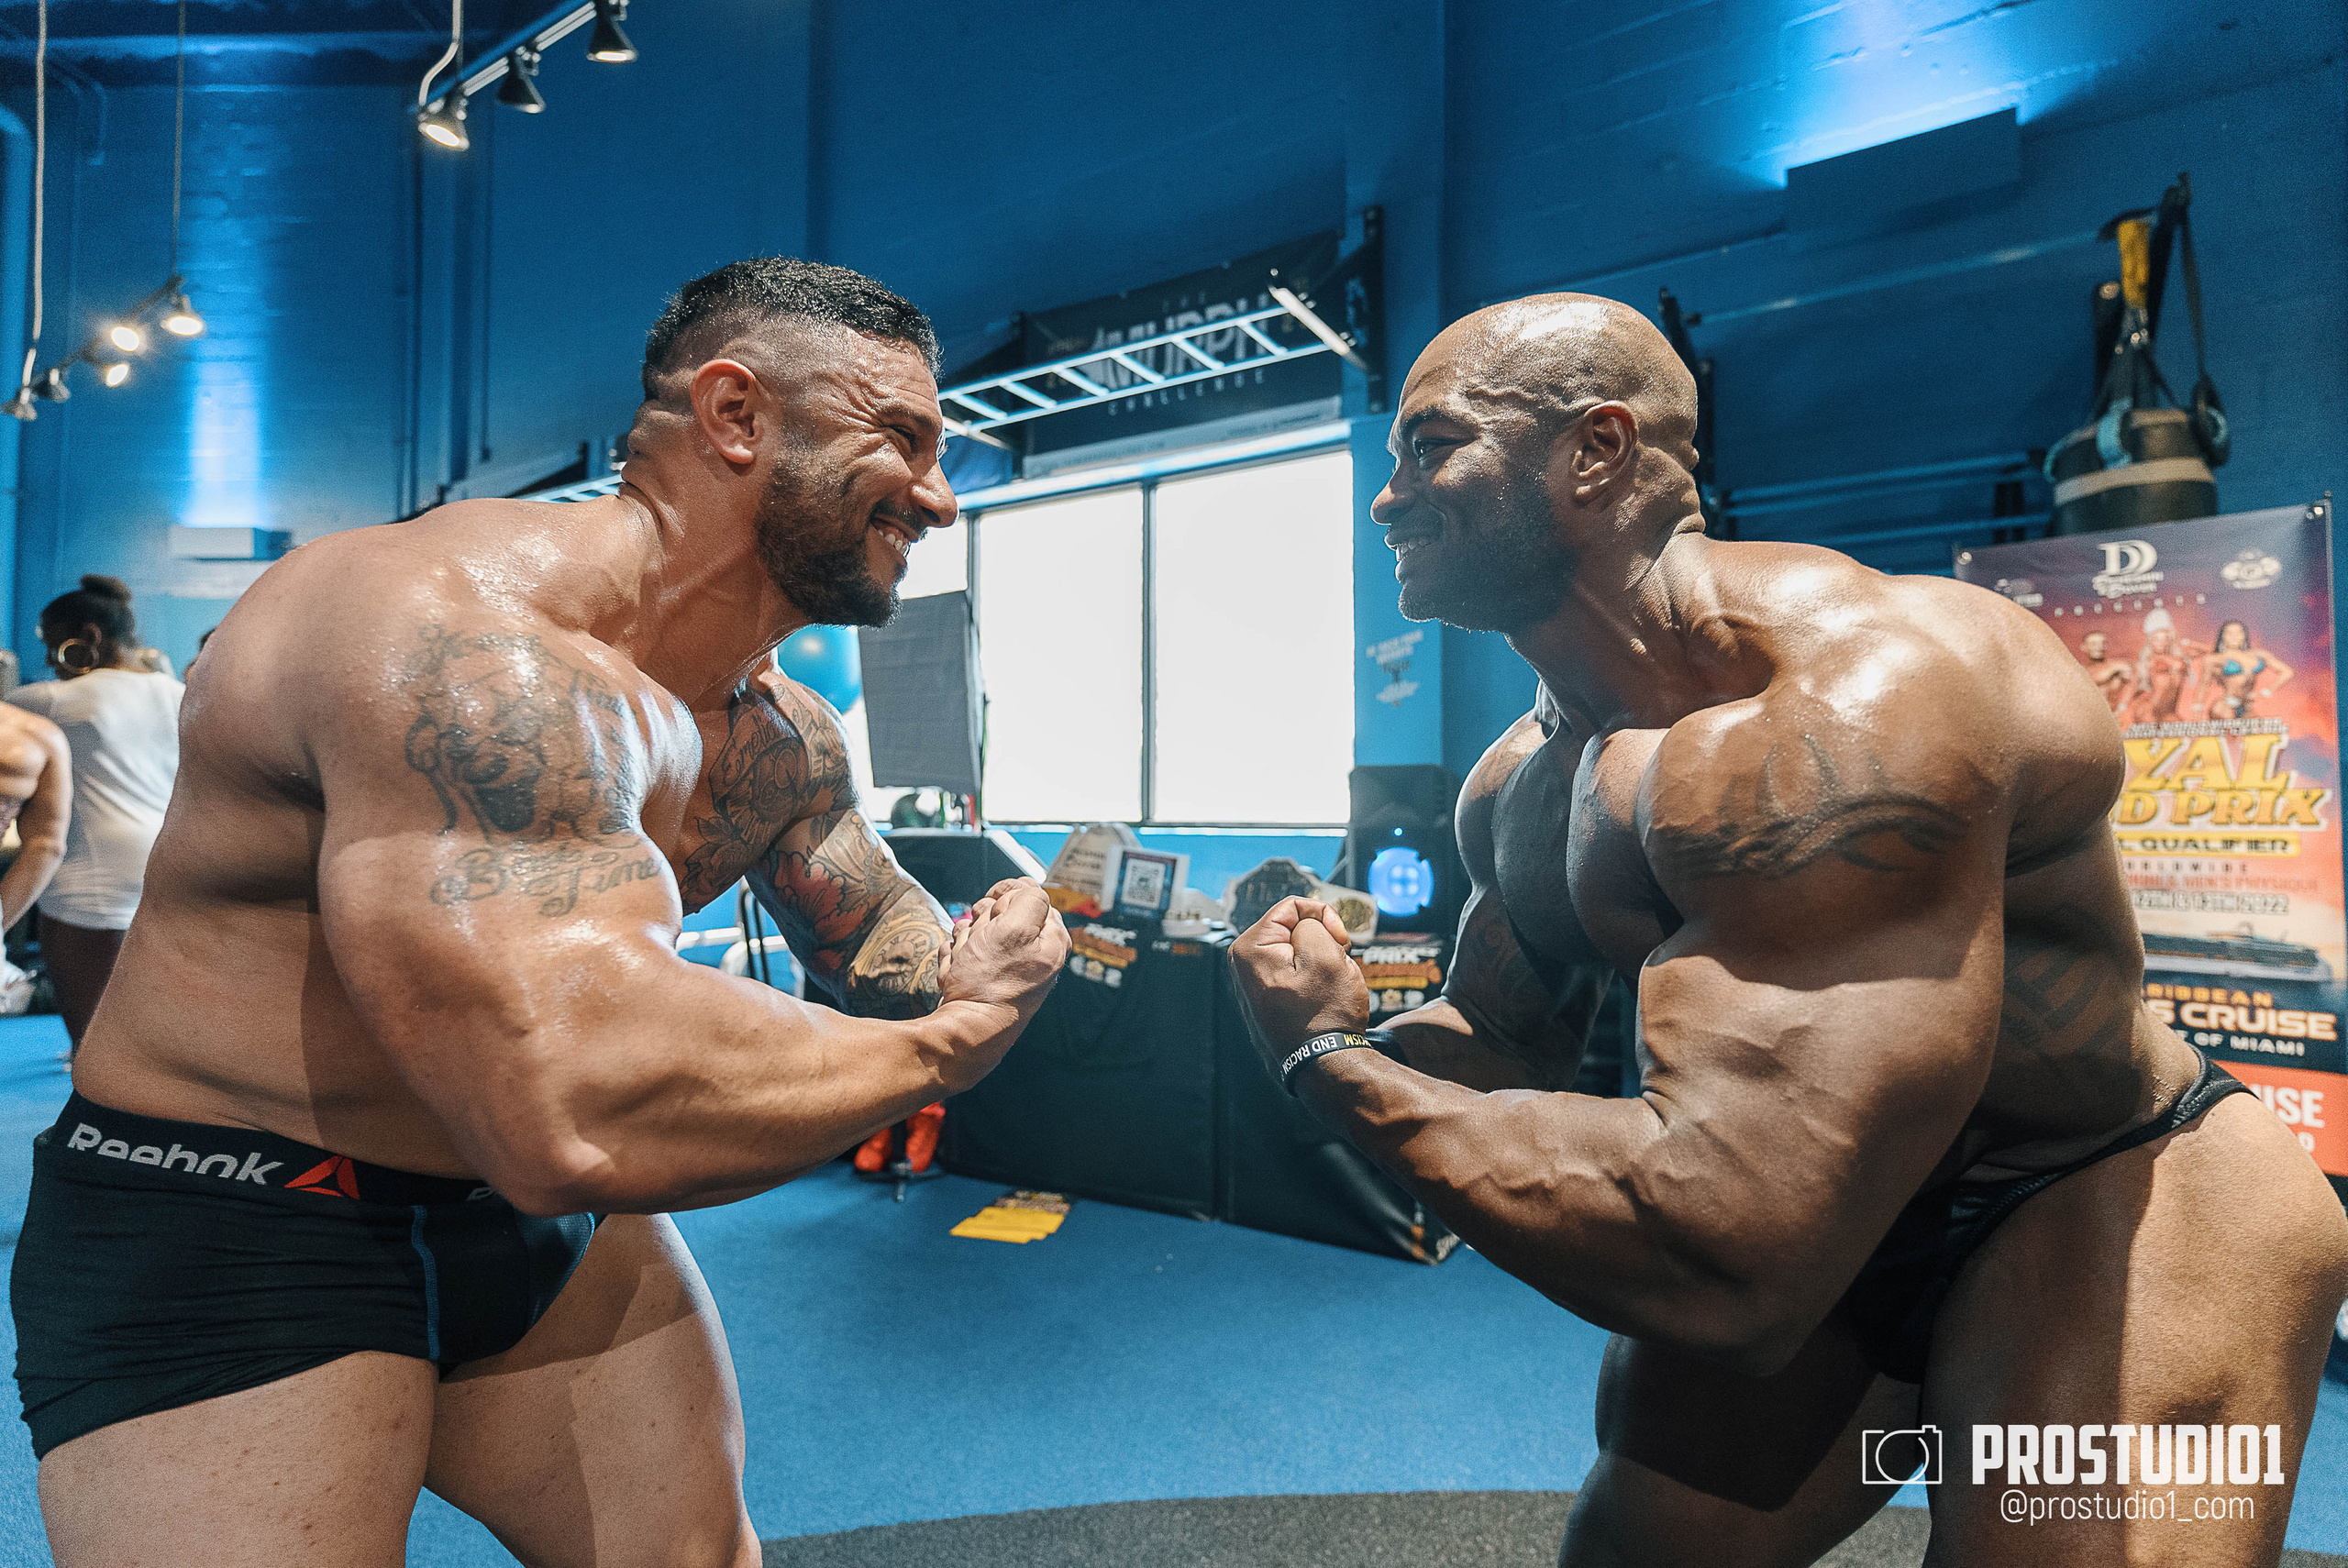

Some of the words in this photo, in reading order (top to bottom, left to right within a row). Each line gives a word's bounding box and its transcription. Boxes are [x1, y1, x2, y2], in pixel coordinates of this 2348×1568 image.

[2170, 789, 2327, 826] PRIX
[2140, 837, 2289, 852] QUALIFIER
[2141, 982, 2274, 1009] RIBBEAN
[2178, 1001, 2339, 1042] CRUISE
[1312, 1036, 1338, 1053] END
[2193, 1032, 2224, 1048] OF
[2230, 1035, 2306, 1057] MIAMI
[1281, 1048, 1312, 1075] RACISM
